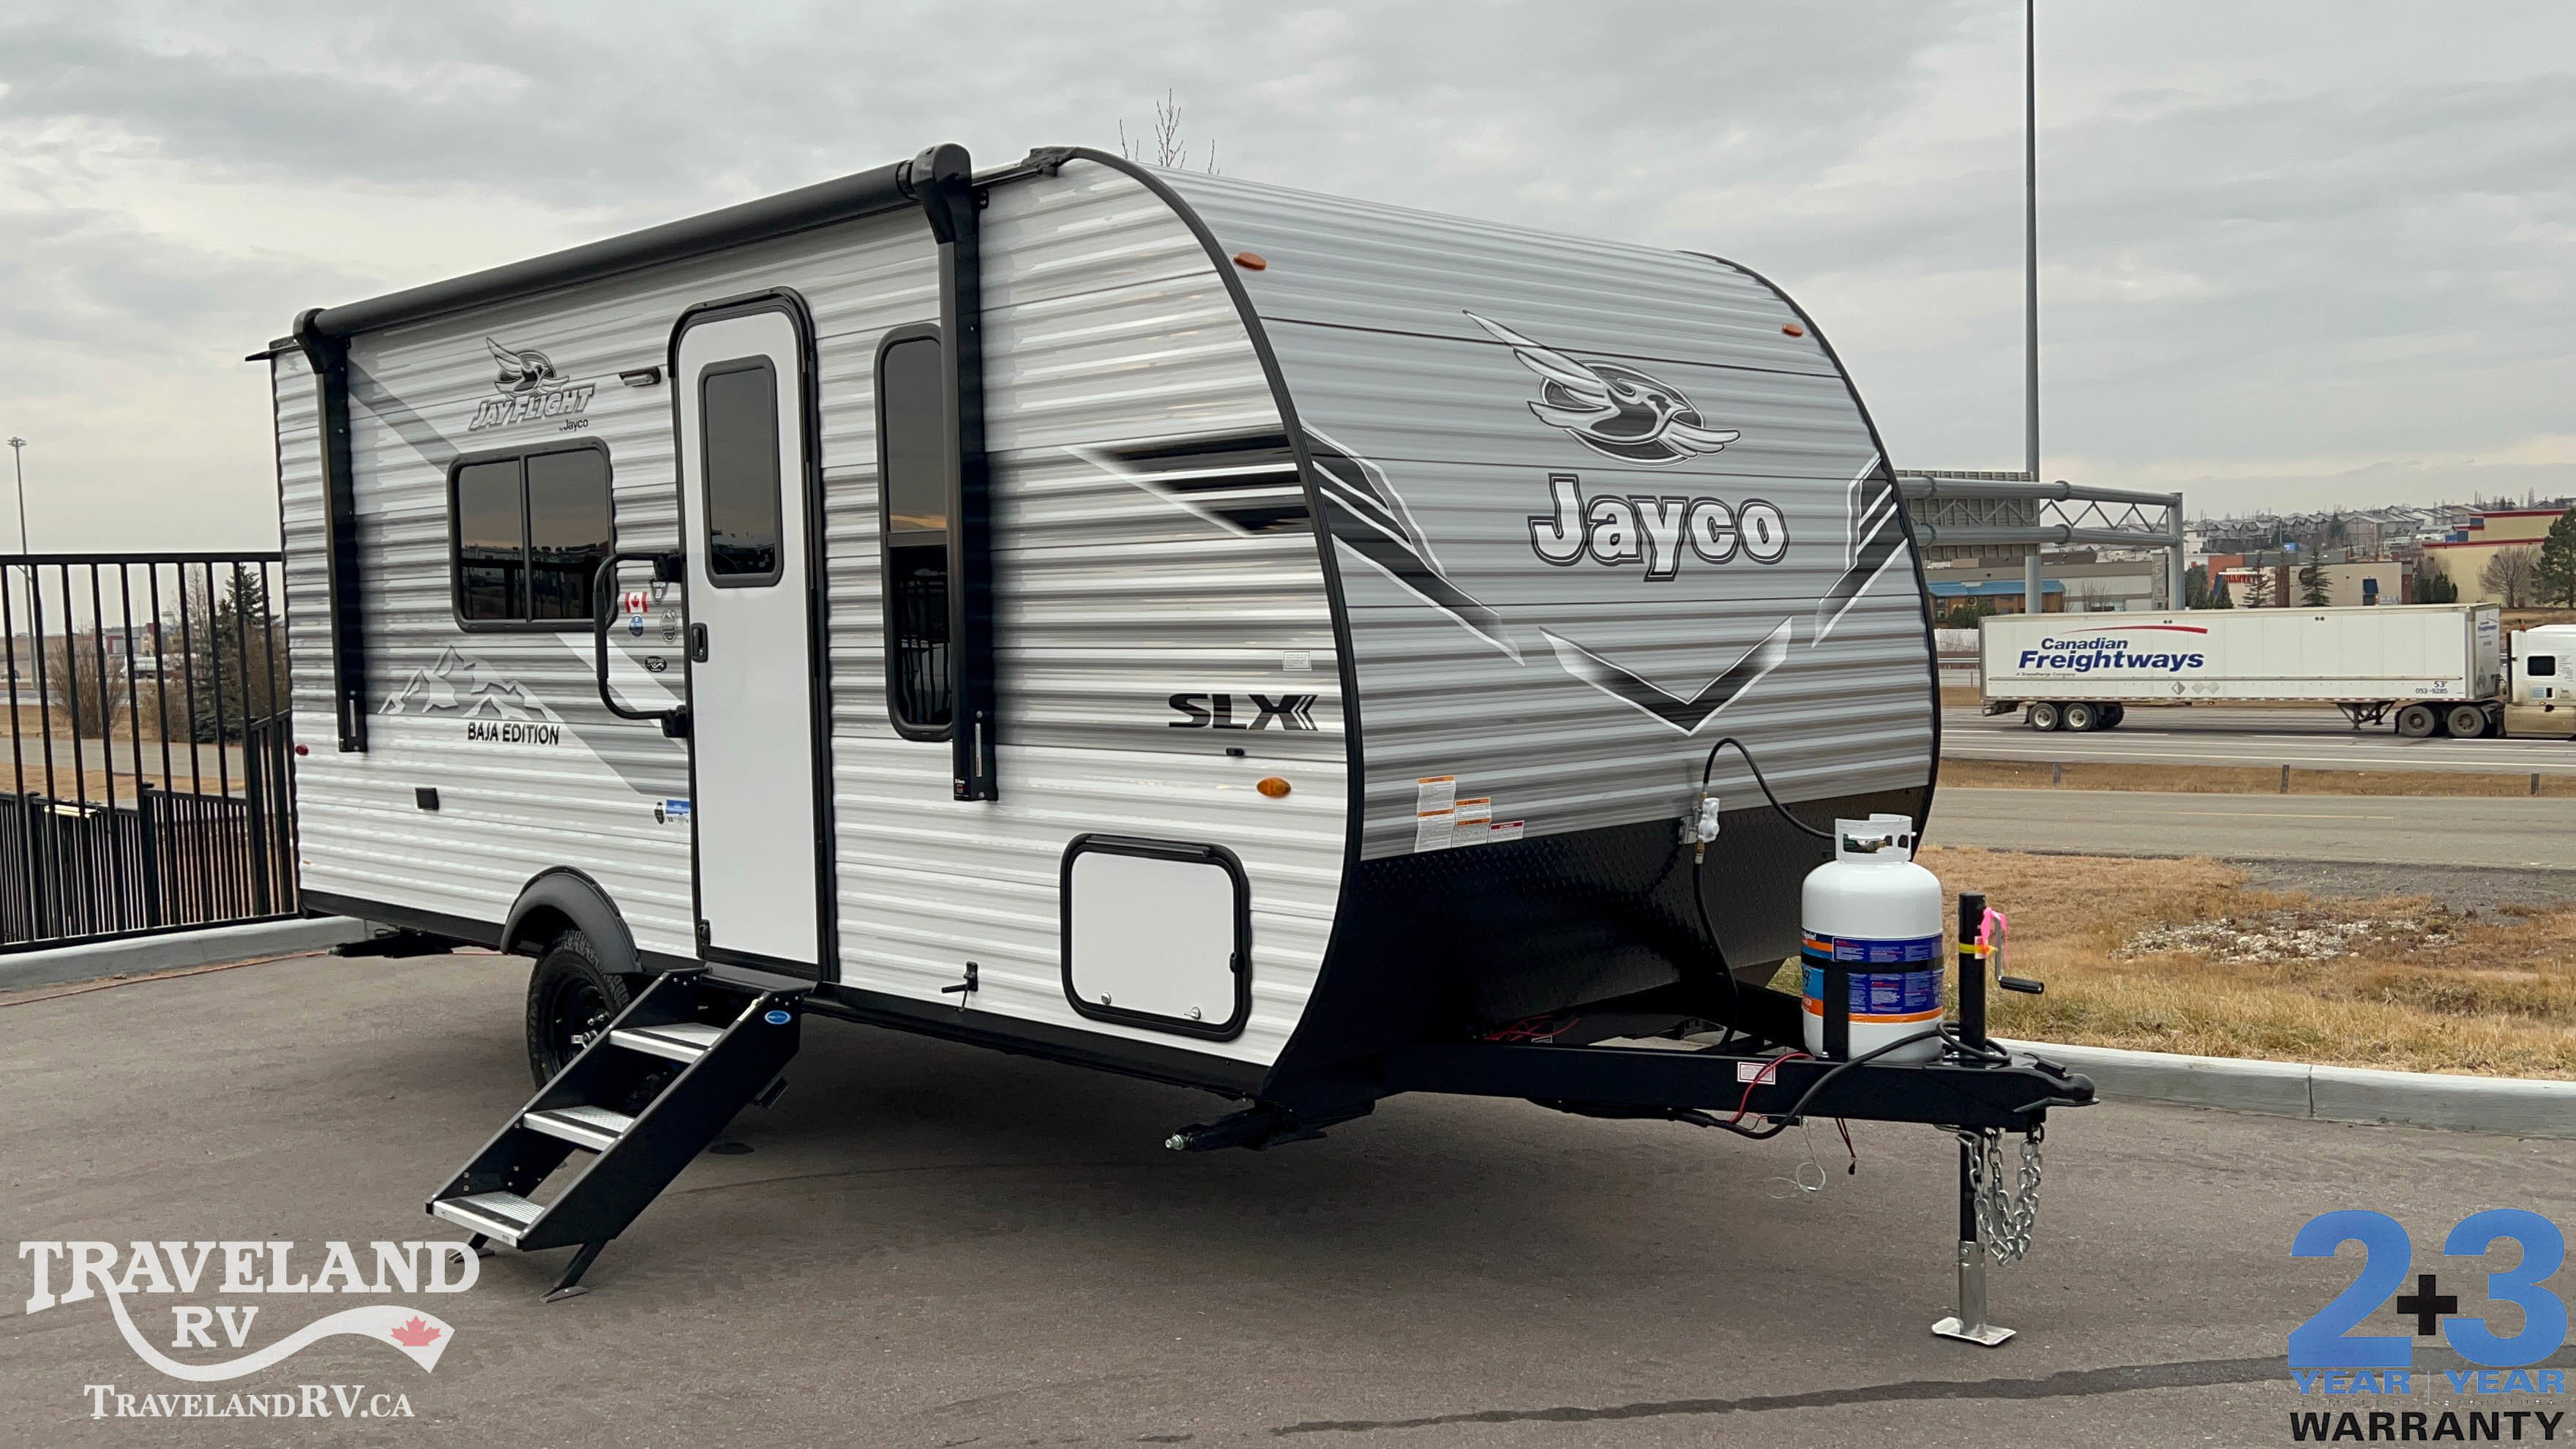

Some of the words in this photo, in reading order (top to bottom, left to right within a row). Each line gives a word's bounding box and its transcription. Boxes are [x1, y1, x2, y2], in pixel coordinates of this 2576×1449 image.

[468, 401, 512, 430] JAY
[510, 386, 595, 422] FLIGHT
[563, 419, 588, 431] Jayco
[1527, 473, 1789, 582] Jayco
[2041, 637, 2128, 649] Canadian
[2019, 651, 2204, 672] Freightways
[1169, 693, 1319, 731] SLX
[468, 722, 498, 741] BAJA
[502, 723, 560, 745] EDITION
